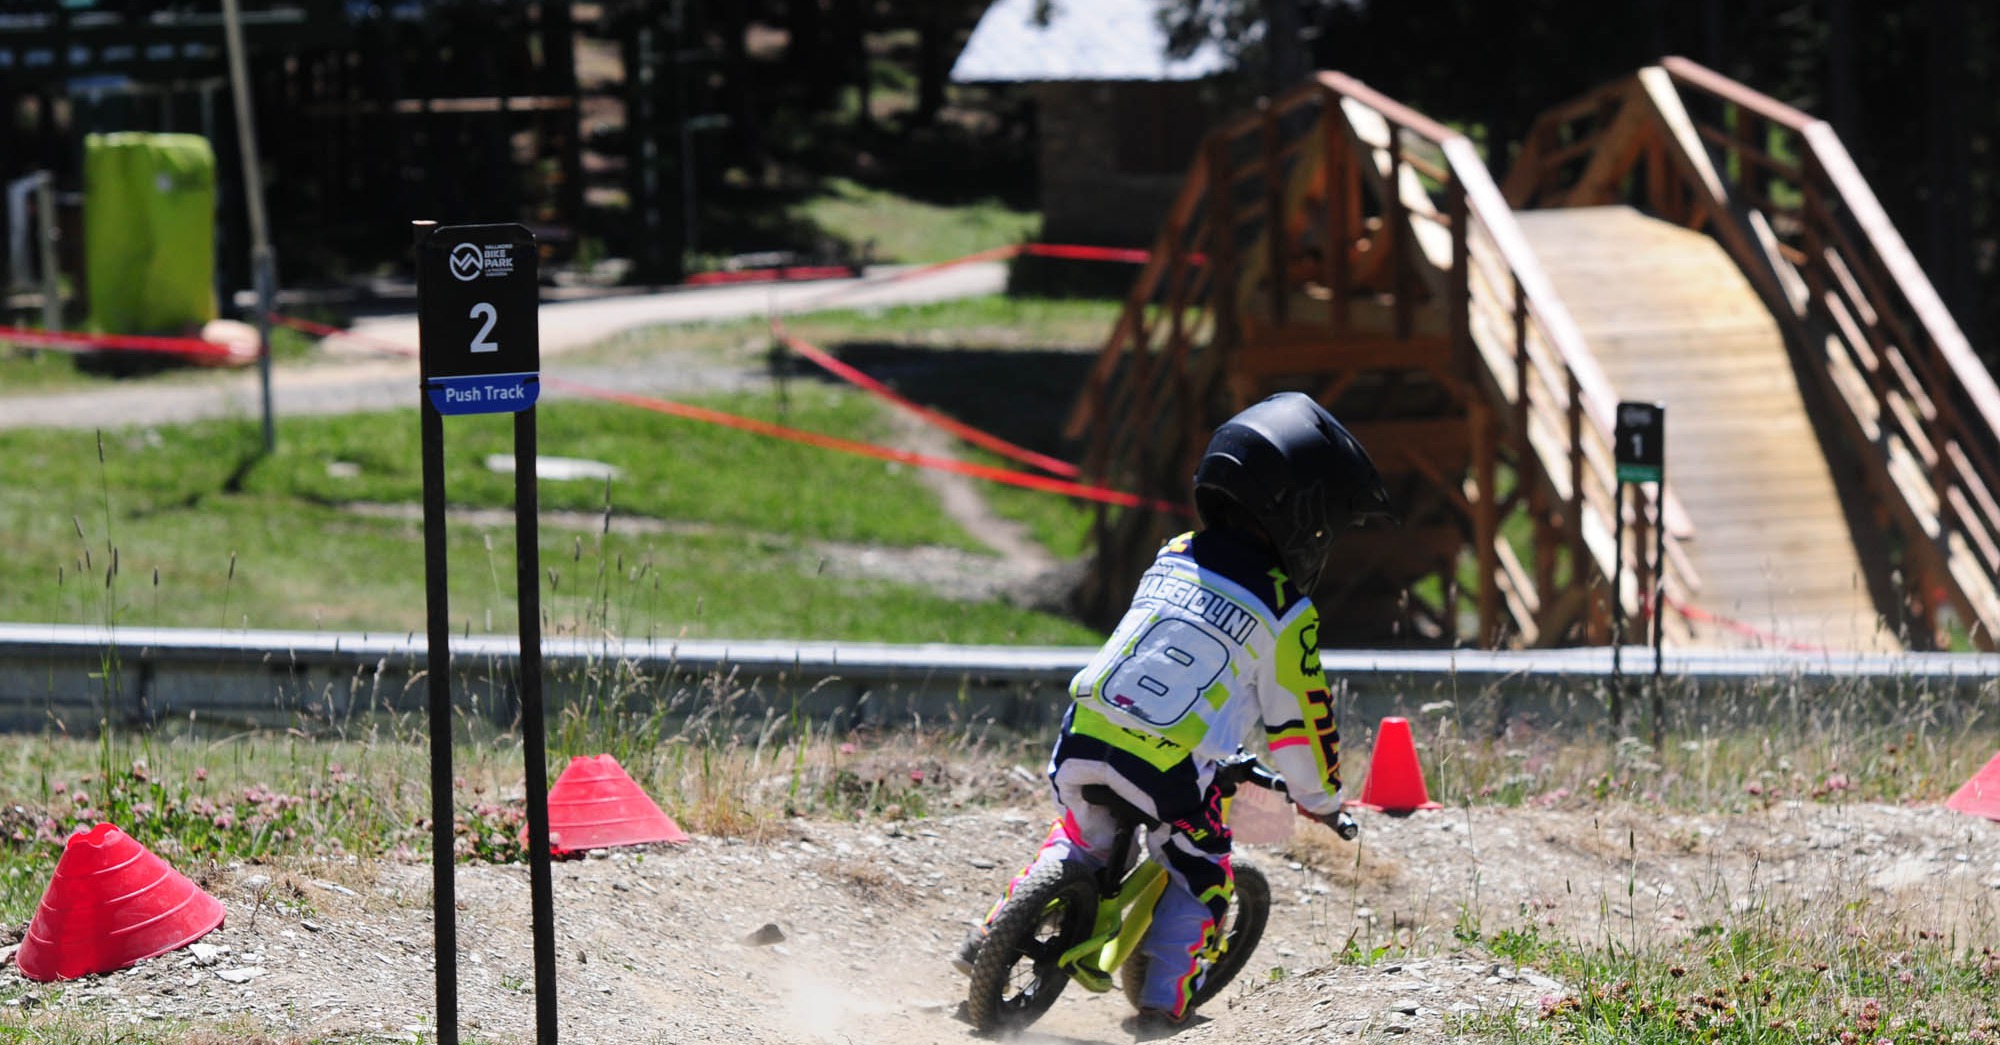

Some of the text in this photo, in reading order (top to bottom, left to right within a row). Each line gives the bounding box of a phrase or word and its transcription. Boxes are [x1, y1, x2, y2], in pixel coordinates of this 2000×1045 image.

[484, 249, 506, 258] BIKE
[484, 257, 513, 268] PARK
[469, 302, 498, 353] 2
[445, 384, 525, 403] Push Track
[1631, 433, 1643, 459] 1
[1075, 605, 1230, 726] 18
